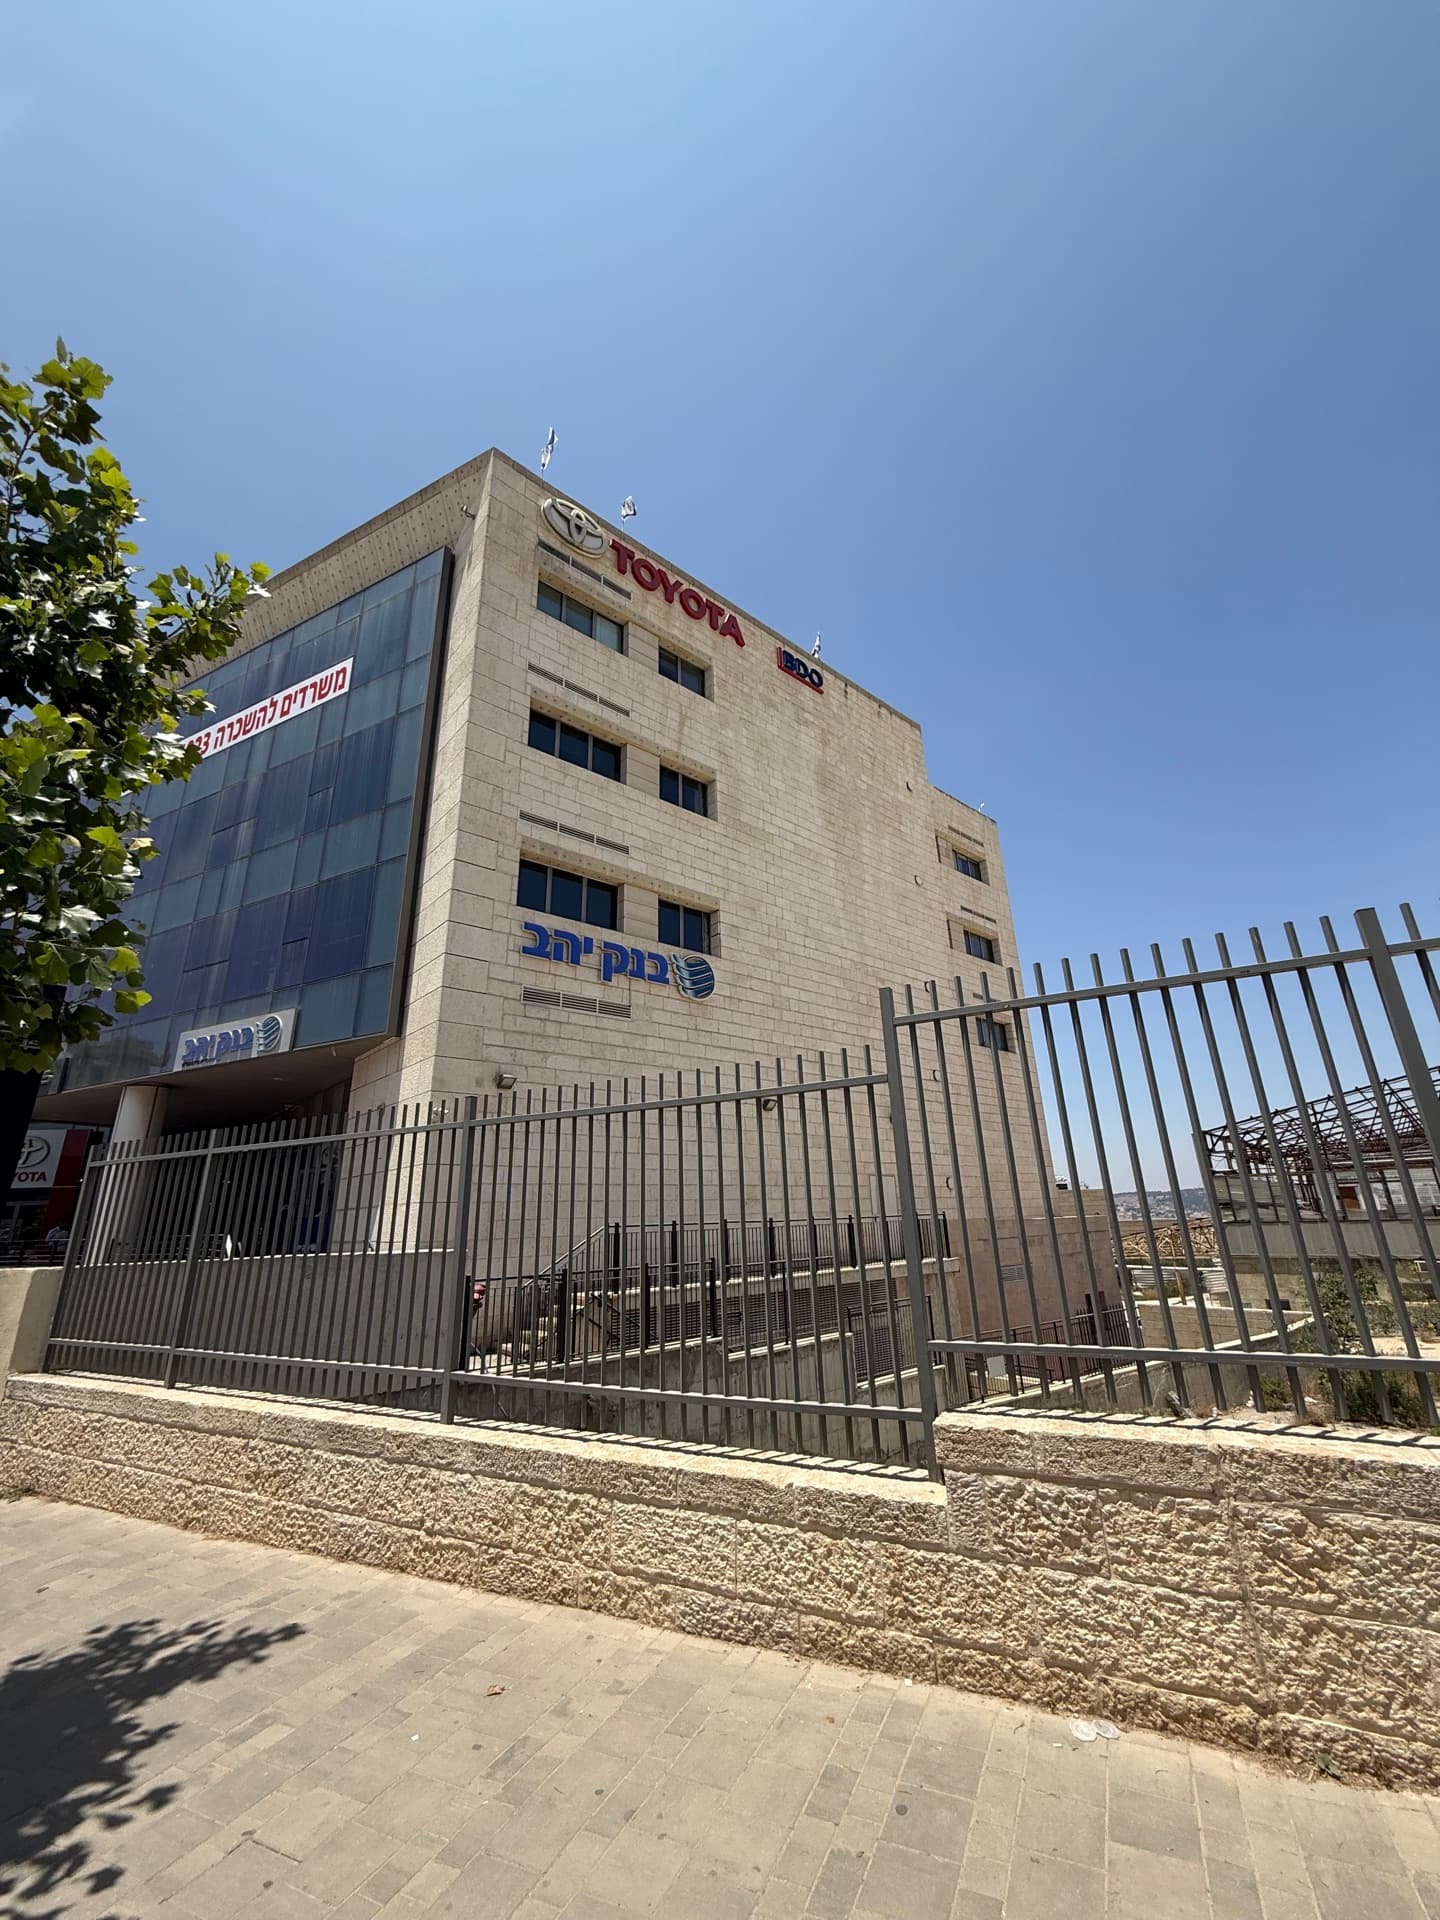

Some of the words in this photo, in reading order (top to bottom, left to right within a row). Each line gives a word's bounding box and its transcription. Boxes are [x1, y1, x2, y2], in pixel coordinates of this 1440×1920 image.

[608, 538, 745, 648] TOYOTA
[782, 649, 824, 688] BDO
[279, 665, 348, 719] משרדים
[213, 696, 278, 750] להשכרה
[520, 920, 594, 966] יהב
[600, 940, 670, 985] בנק
[181, 1034, 216, 1061] יהב
[214, 1026, 254, 1061] בנק
